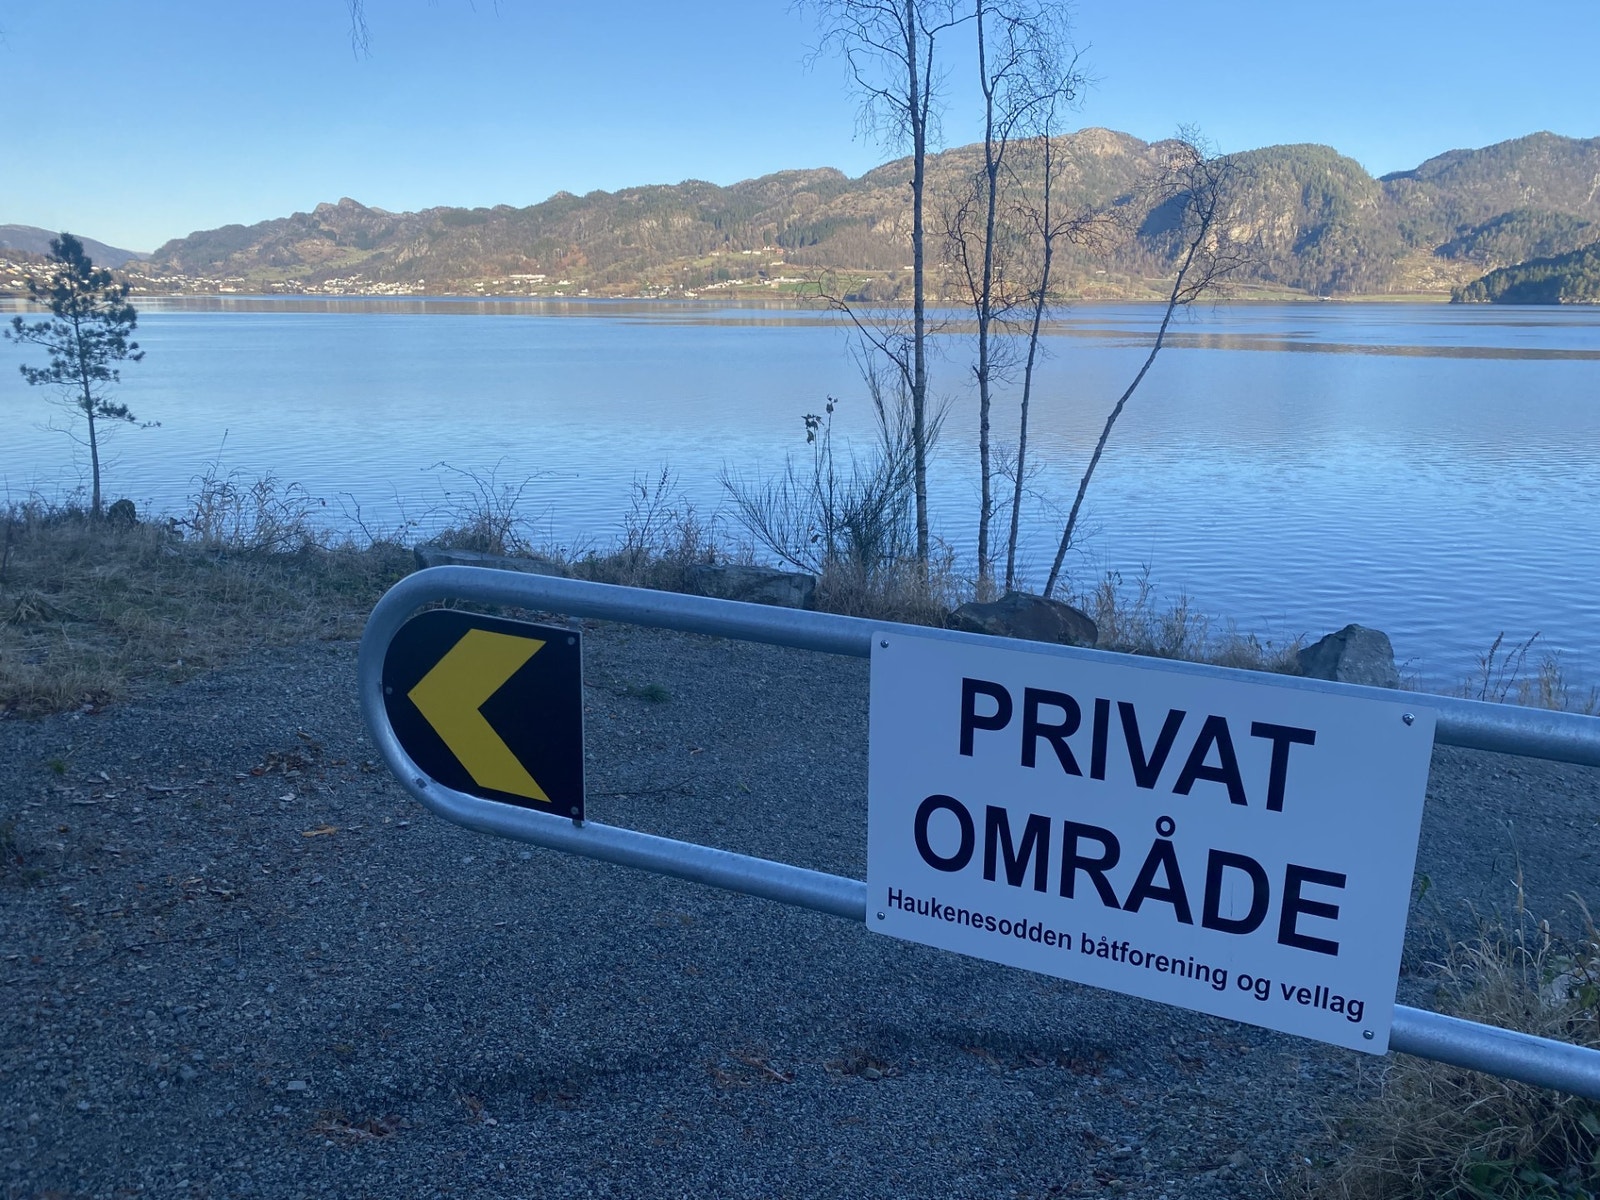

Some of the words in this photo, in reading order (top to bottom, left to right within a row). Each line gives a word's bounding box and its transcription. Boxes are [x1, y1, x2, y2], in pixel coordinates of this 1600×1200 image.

[959, 677, 1316, 812] PRIVAT
[914, 794, 1346, 956] OMRÅDE
[887, 887, 1072, 951] Haukenesodden
[1081, 931, 1228, 992] båtforening
[1236, 974, 1271, 1001] og
[1281, 983, 1364, 1023] vellag
